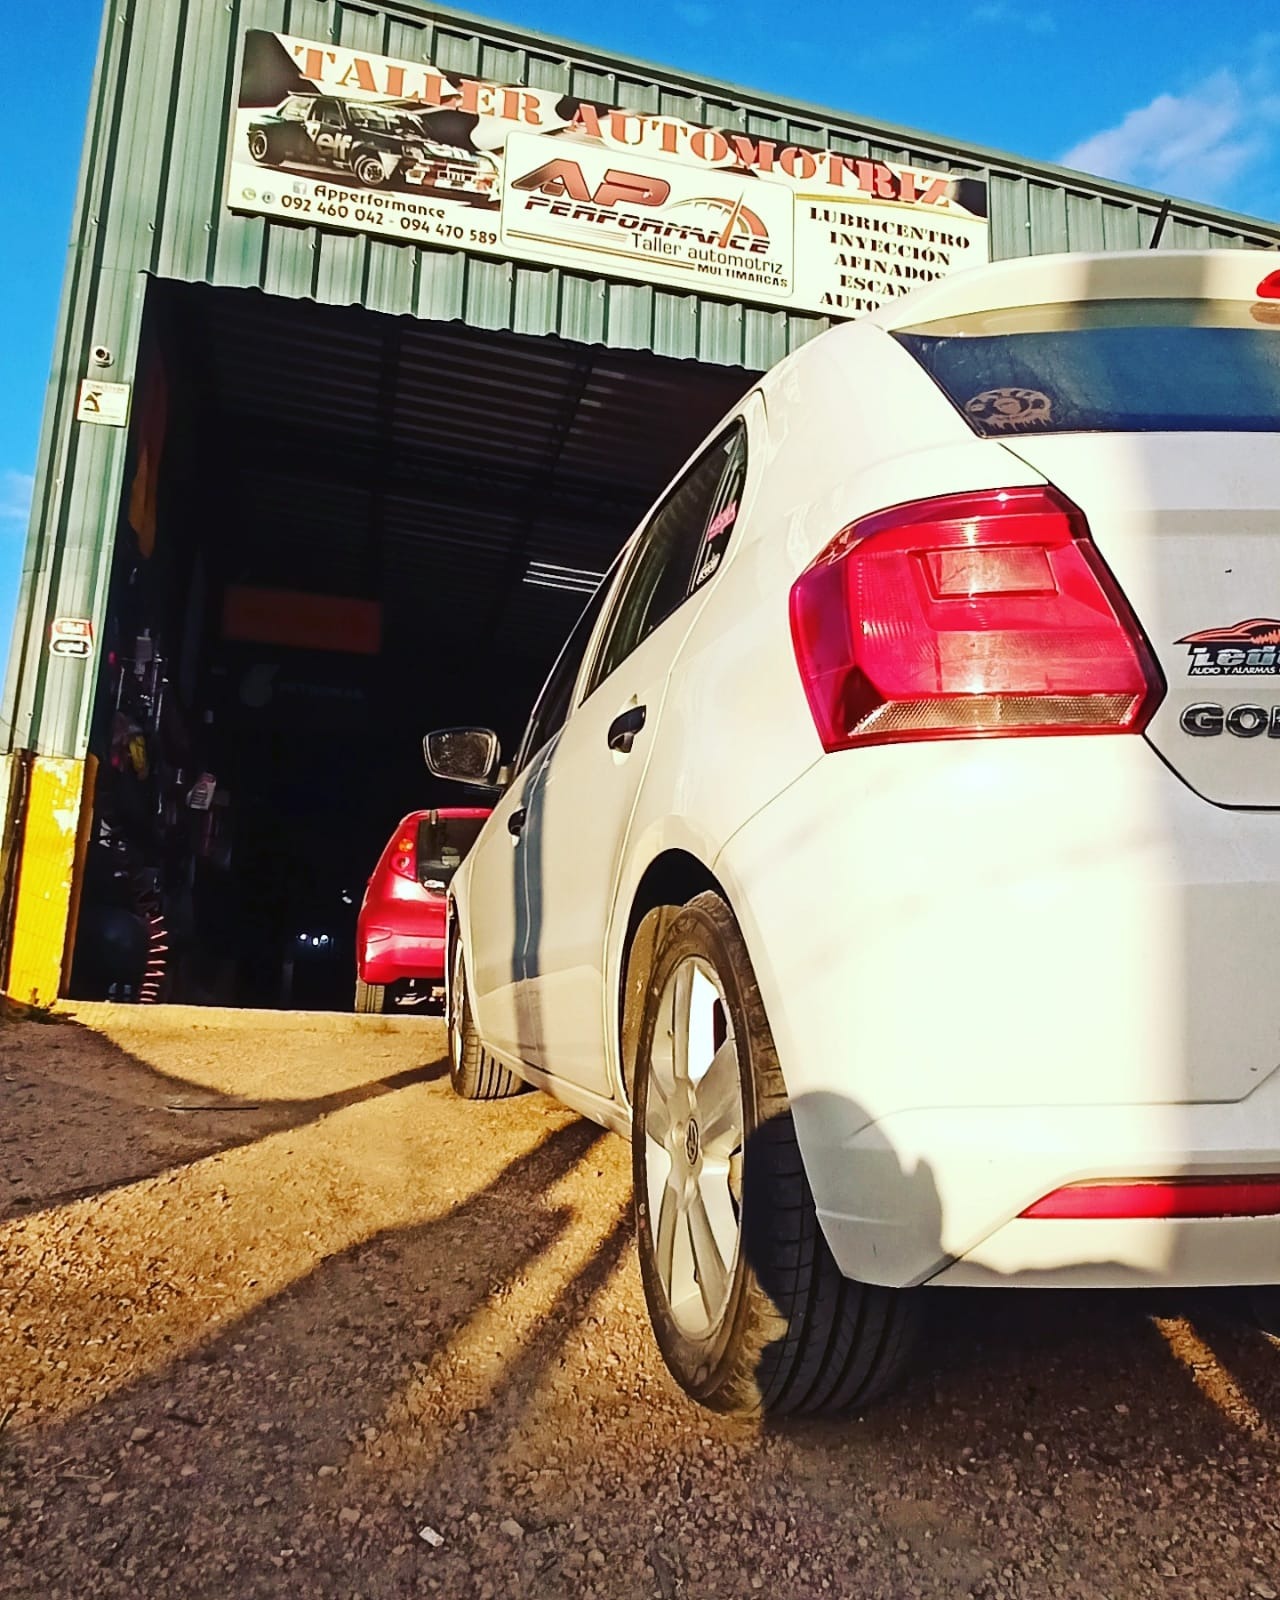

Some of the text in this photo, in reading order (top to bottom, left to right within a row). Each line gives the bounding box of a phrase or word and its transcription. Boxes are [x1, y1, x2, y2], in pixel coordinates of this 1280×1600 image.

[295, 45, 950, 208] TALLER AUTOMOTRIZ
[315, 132, 352, 160] elf
[314, 185, 446, 219] Apperformance
[511, 158, 671, 207] AP
[281, 195, 312, 212] 092
[317, 202, 349, 219] 460
[355, 208, 384, 226] 042
[400, 217, 430, 234] 094
[435, 223, 464, 240] 470
[469, 229, 497, 245] 589
[524, 195, 771, 255] PERFORMANCE
[809, 207, 970, 249] LUBRICENTRO
[632, 233, 783, 275] Taller automotriz
[829, 230, 950, 266] INYECCIÓN
[697, 263, 788, 288] MULTIMARCAS
[1232, 666, 1276, 674] ALARMAS
